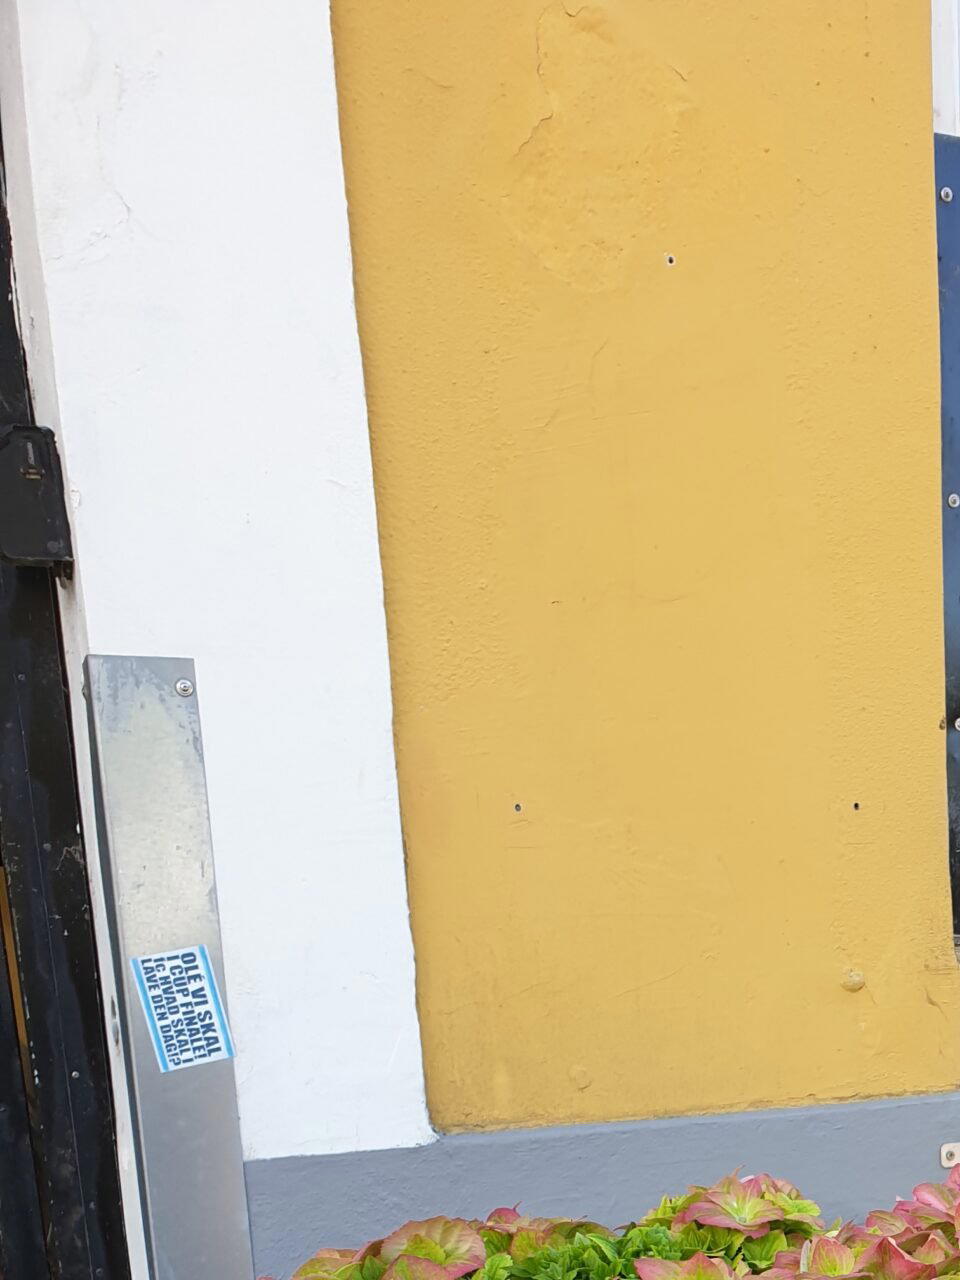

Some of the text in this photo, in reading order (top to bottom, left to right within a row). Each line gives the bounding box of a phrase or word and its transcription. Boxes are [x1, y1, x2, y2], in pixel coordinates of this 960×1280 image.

[141, 958, 161, 992] LAVE
[151, 995, 168, 1022] DEN
[158, 975, 180, 1016] HVAD
[171, 1018, 190, 1056] SKAL
[169, 964, 190, 998] CUP
[180, 1001, 208, 1060] FINALE!
[180, 951, 222, 1058] OLÉ VI SKAL
